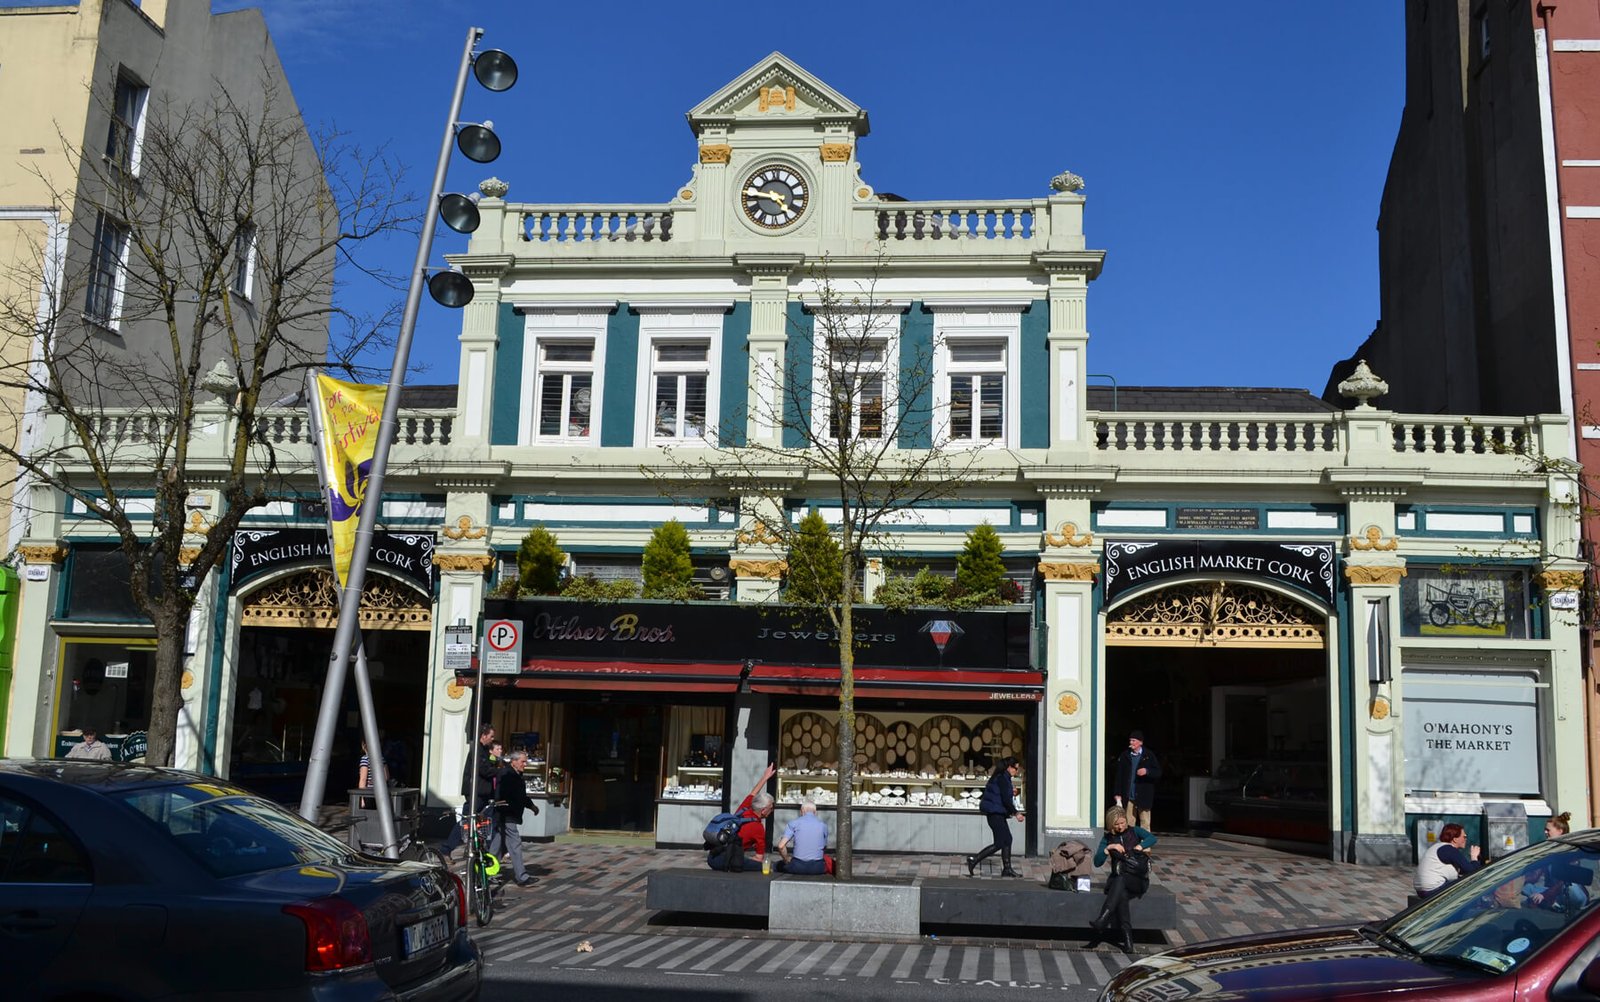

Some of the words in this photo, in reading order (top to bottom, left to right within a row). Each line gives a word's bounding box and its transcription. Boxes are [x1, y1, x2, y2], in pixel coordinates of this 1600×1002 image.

[250, 544, 311, 566] ENGLISH
[376, 548, 416, 571] CORK
[1127, 556, 1195, 581] ENGLISH
[1200, 556, 1265, 571] MARKET
[1268, 560, 1315, 583] CORK
[533, 612, 608, 641] Hilser
[610, 613, 675, 642] Bros.
[757, 627, 896, 642] Jewelers
[457, 635, 462, 644] L
[1424, 722, 1513, 736] O'MAHONY'S
[1426, 739, 1453, 750] THE
[1456, 740, 1511, 751] MARKET
